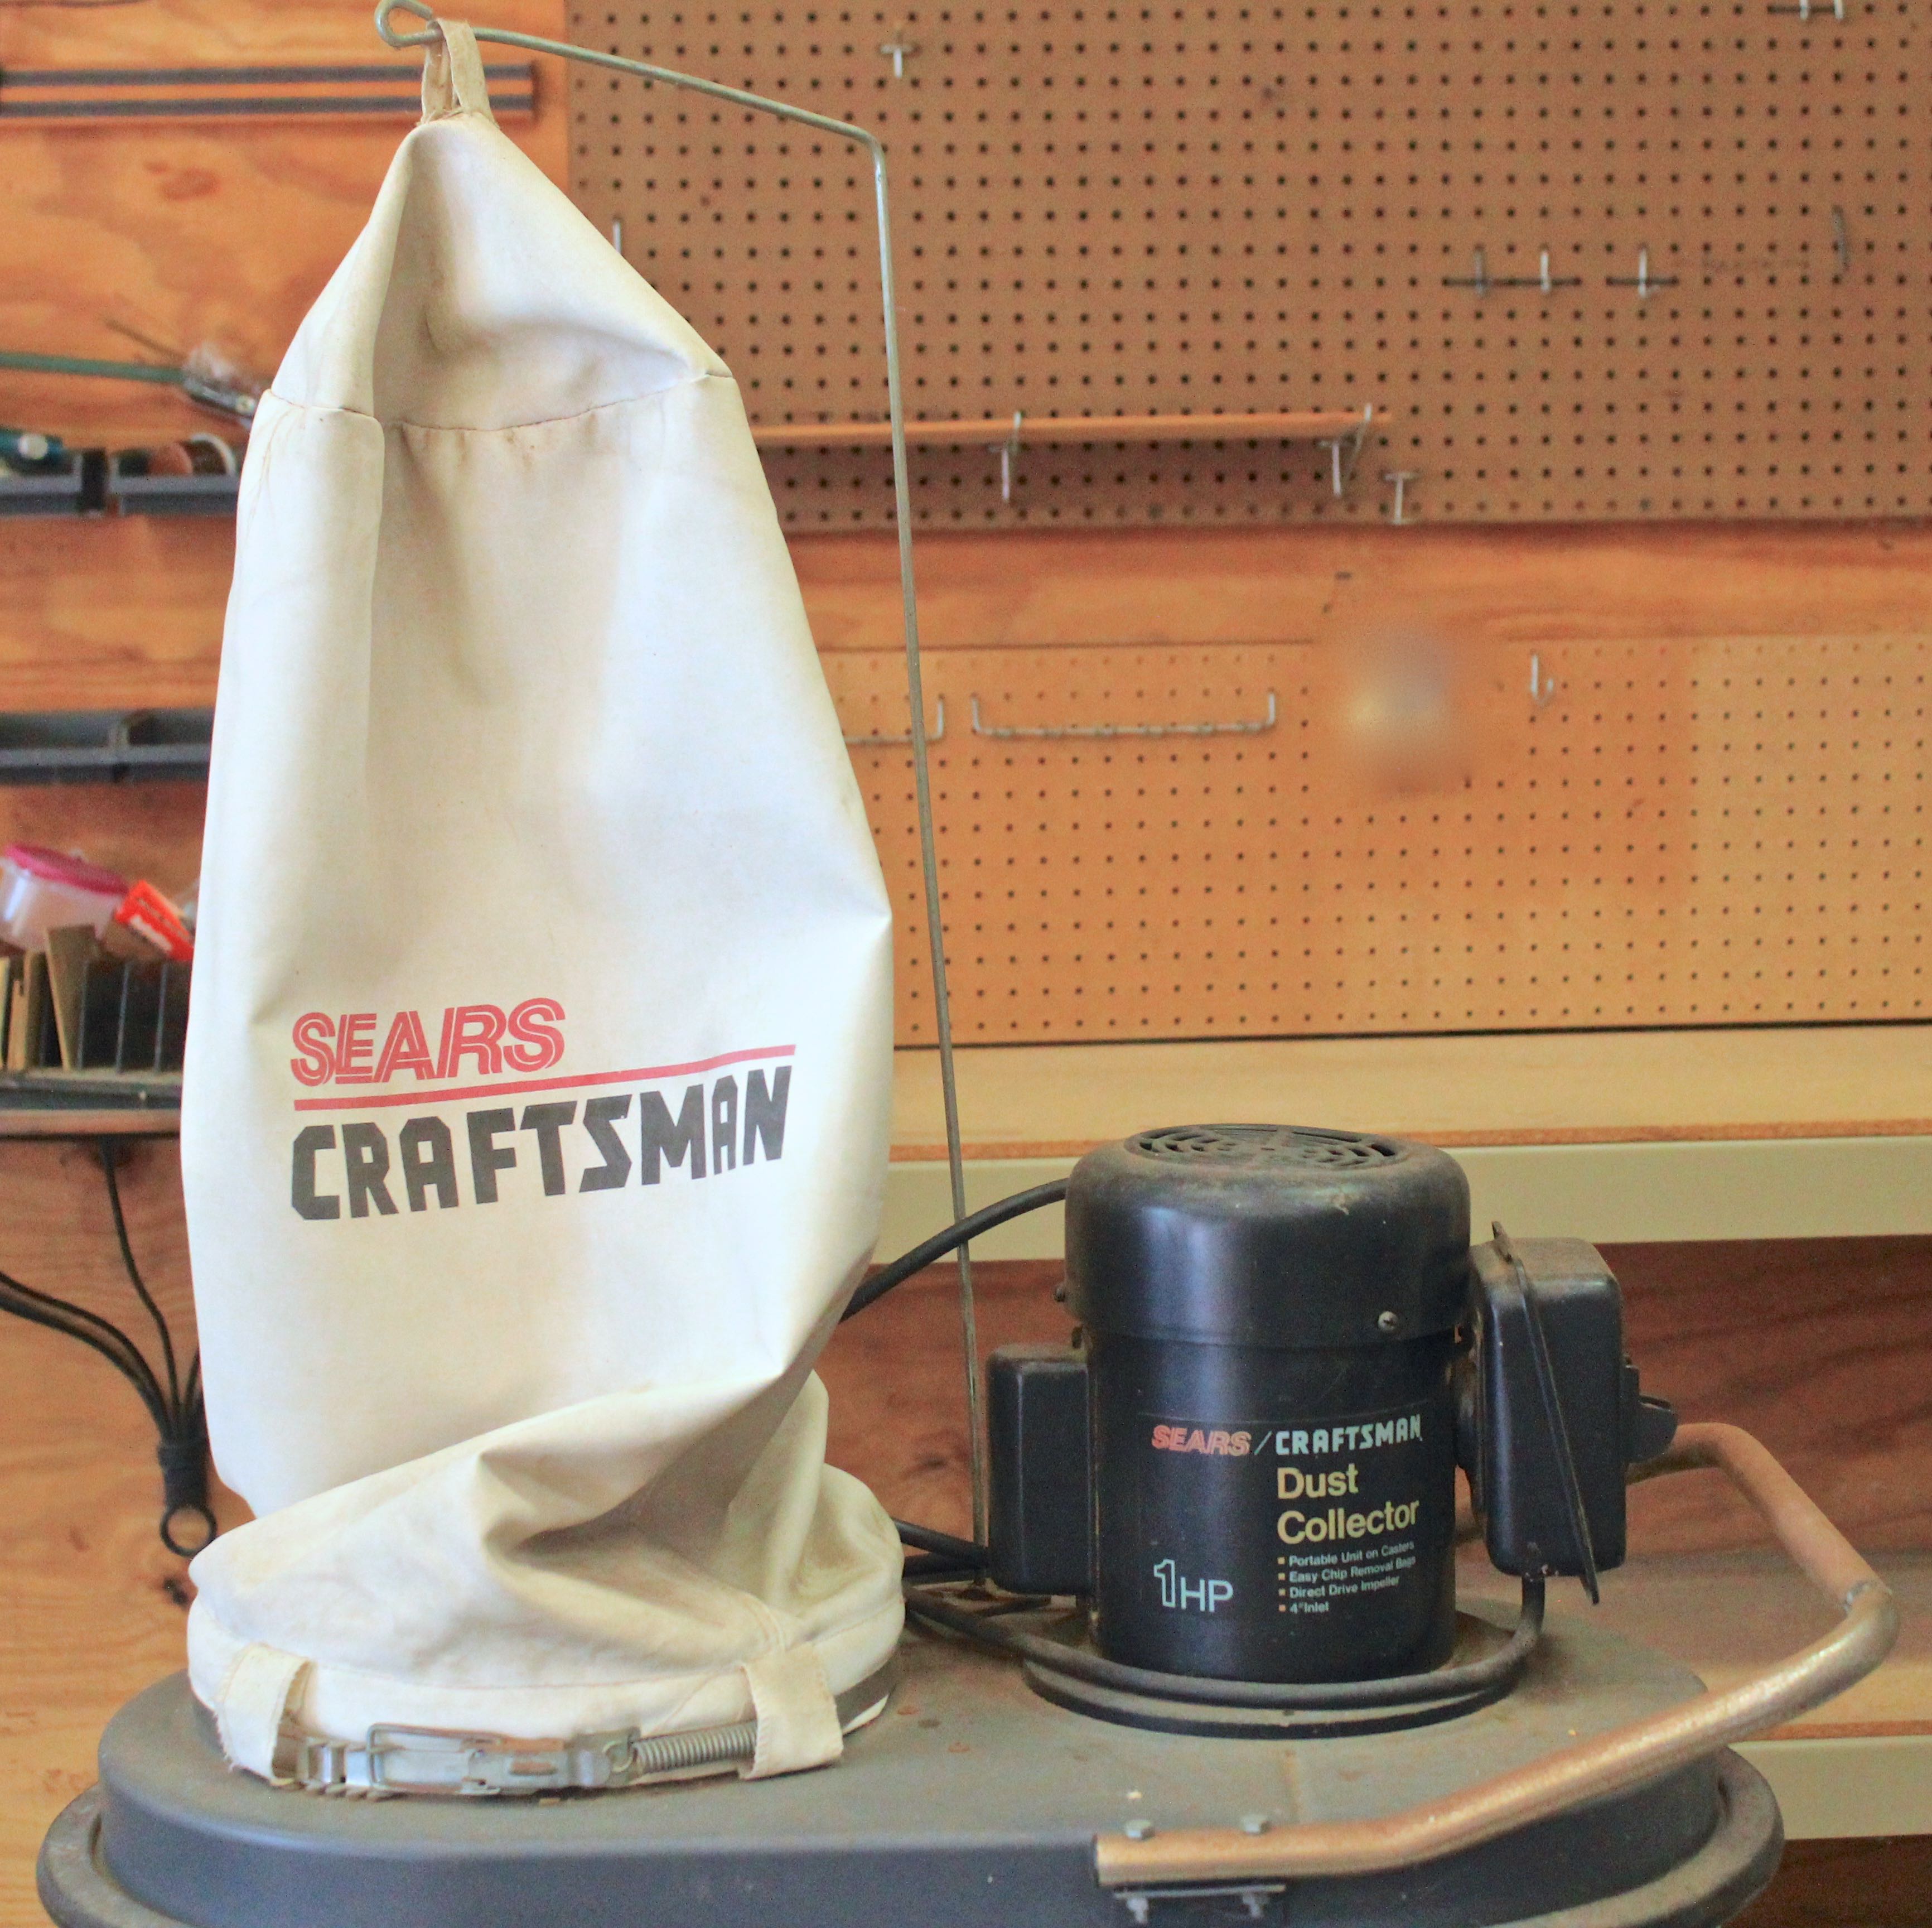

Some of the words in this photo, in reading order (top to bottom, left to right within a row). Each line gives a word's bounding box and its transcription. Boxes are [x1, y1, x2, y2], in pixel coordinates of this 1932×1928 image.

[291, 997, 565, 1086] SEARS
[291, 1066, 792, 1221] CRAFTSMAN
[1152, 1425, 1251, 1456] SEARS
[1276, 1414, 1421, 1455] CRAFTSMAN
[1277, 1463, 1359, 1500] Dust
[1277, 1500, 1420, 1545] Collector
[1289, 1553, 1338, 1566] Portable
[1341, 1550, 1363, 1563] Unit
[1366, 1549, 1378, 1559] on
[1381, 1541, 1415, 1556] Casters
[1289, 1570, 1318, 1583] Easy
[1321, 1568, 1347, 1580] Chip
[1350, 1560, 1393, 1578] Removal
[1289, 1585, 1325, 1599] Direct
[1329, 1583, 1358, 1596] Drive
[1361, 1576, 1400, 1592] Impeller
